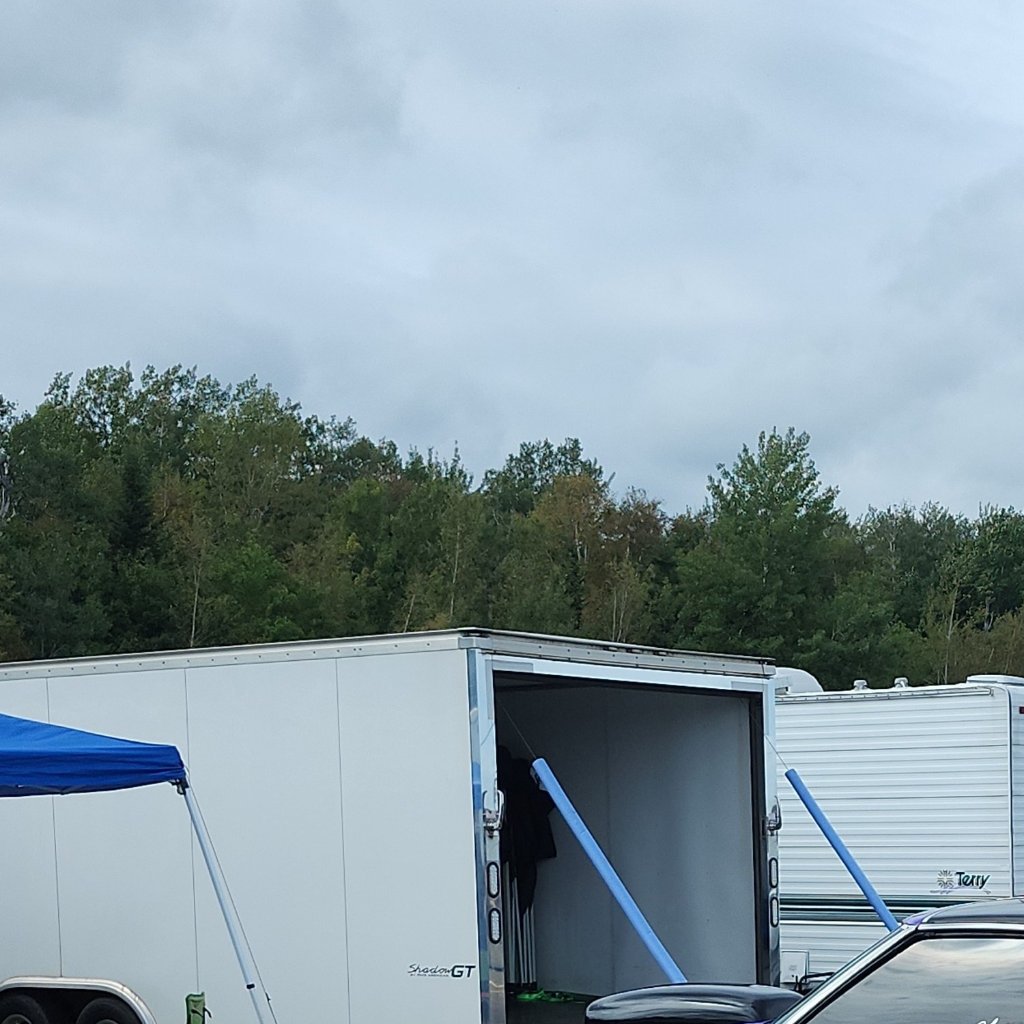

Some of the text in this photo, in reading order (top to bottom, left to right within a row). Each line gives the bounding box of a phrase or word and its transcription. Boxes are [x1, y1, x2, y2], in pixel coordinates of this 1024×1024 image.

[955, 871, 991, 889] Terry
[407, 963, 477, 978] Shadow GT
